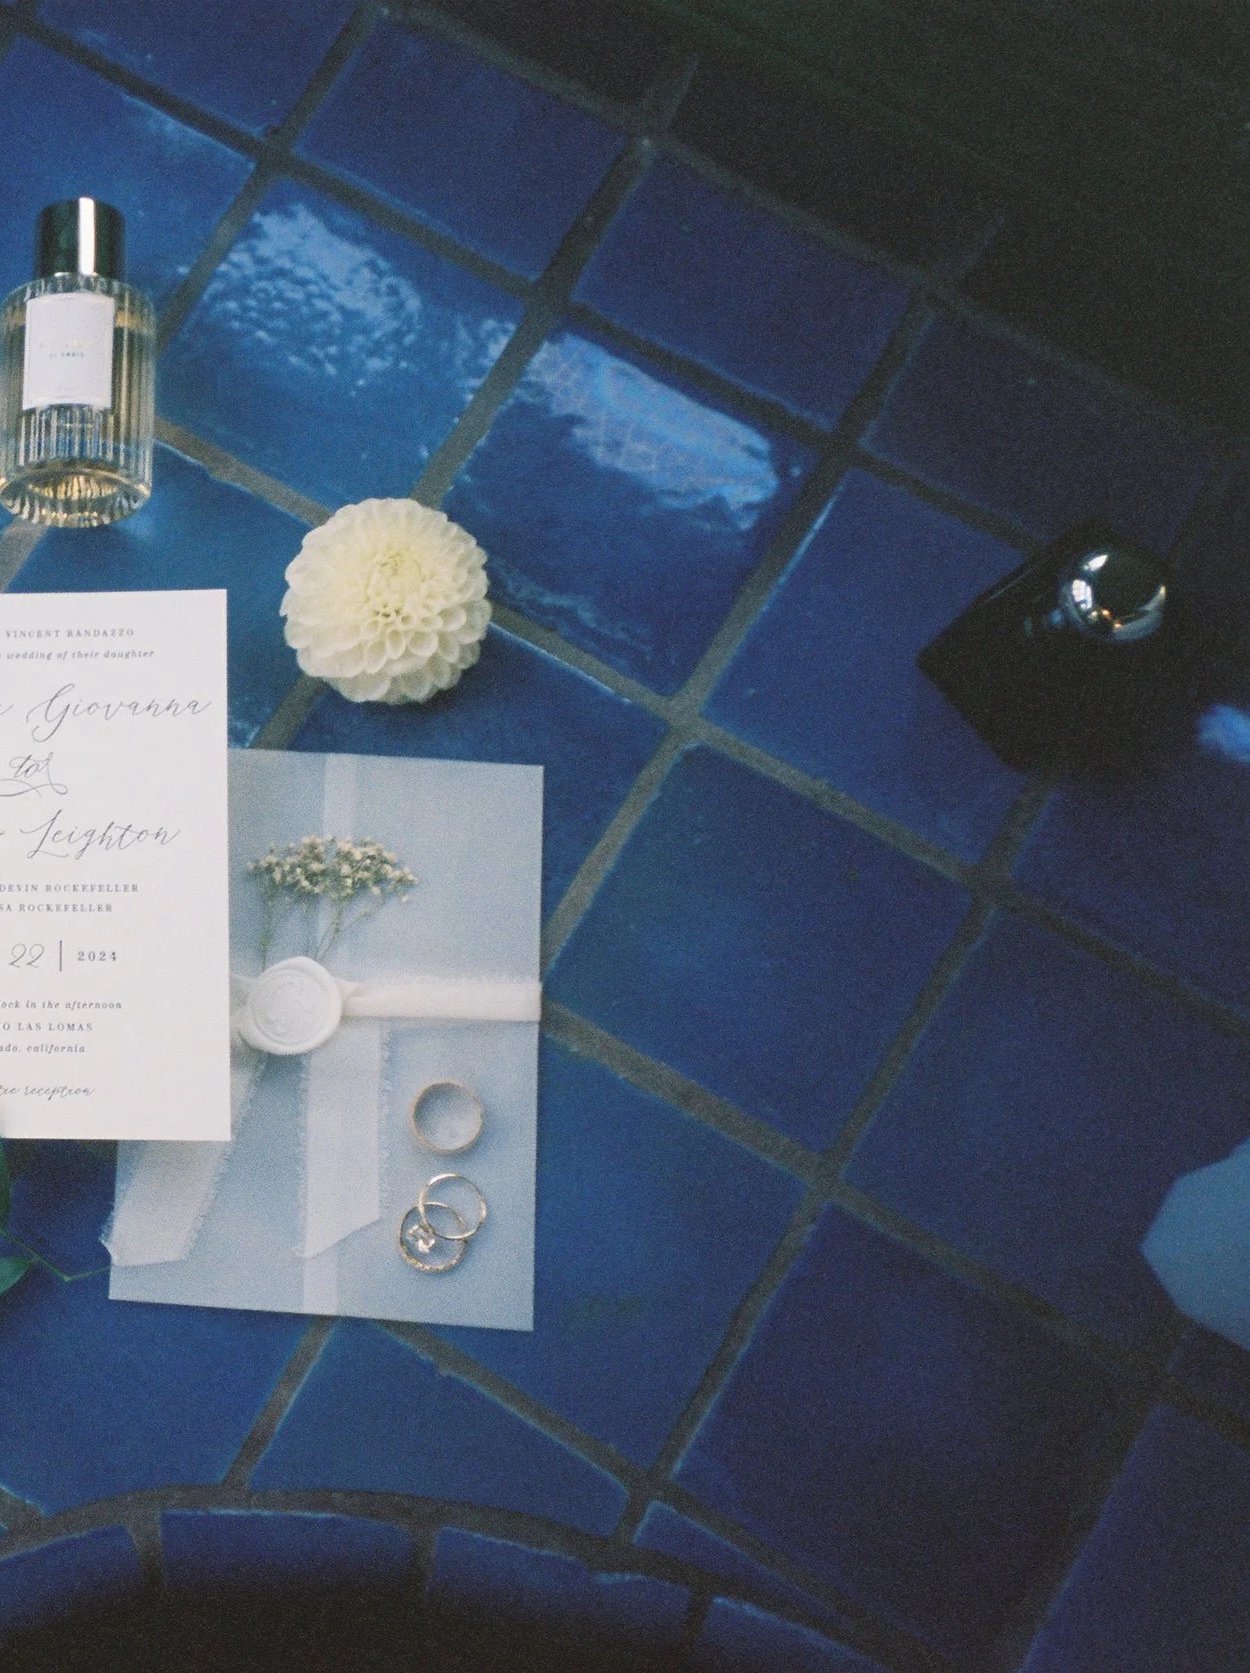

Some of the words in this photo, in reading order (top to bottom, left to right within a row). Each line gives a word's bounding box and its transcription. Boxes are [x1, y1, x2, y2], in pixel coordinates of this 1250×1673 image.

[5, 629, 61, 638] VINCENT
[67, 629, 135, 638] RANDAZZO
[7, 651, 52, 661] wedding
[57, 650, 68, 661] of
[72, 650, 99, 659] their
[104, 650, 155, 661] daughter
[26, 683, 212, 742] Giovanna
[20, 809, 181, 861] Leighton
[0, 884, 38, 892] DEVIN
[46, 884, 139, 892] ROCKEFELLER
[19, 904, 113, 912] ROCKEFELLER
[8, 943, 45, 968] 22
[77, 951, 117, 962] 2024
[26, 1000, 37, 1008] in
[42, 1001, 60, 1009] the
[65, 1000, 122, 1010] afternoon
[18, 1023, 42, 1031] LAS
[48, 1023, 93, 1031] LOMAS
[27, 1044, 85, 1054] california
[24, 1085, 95, 1100] reception
